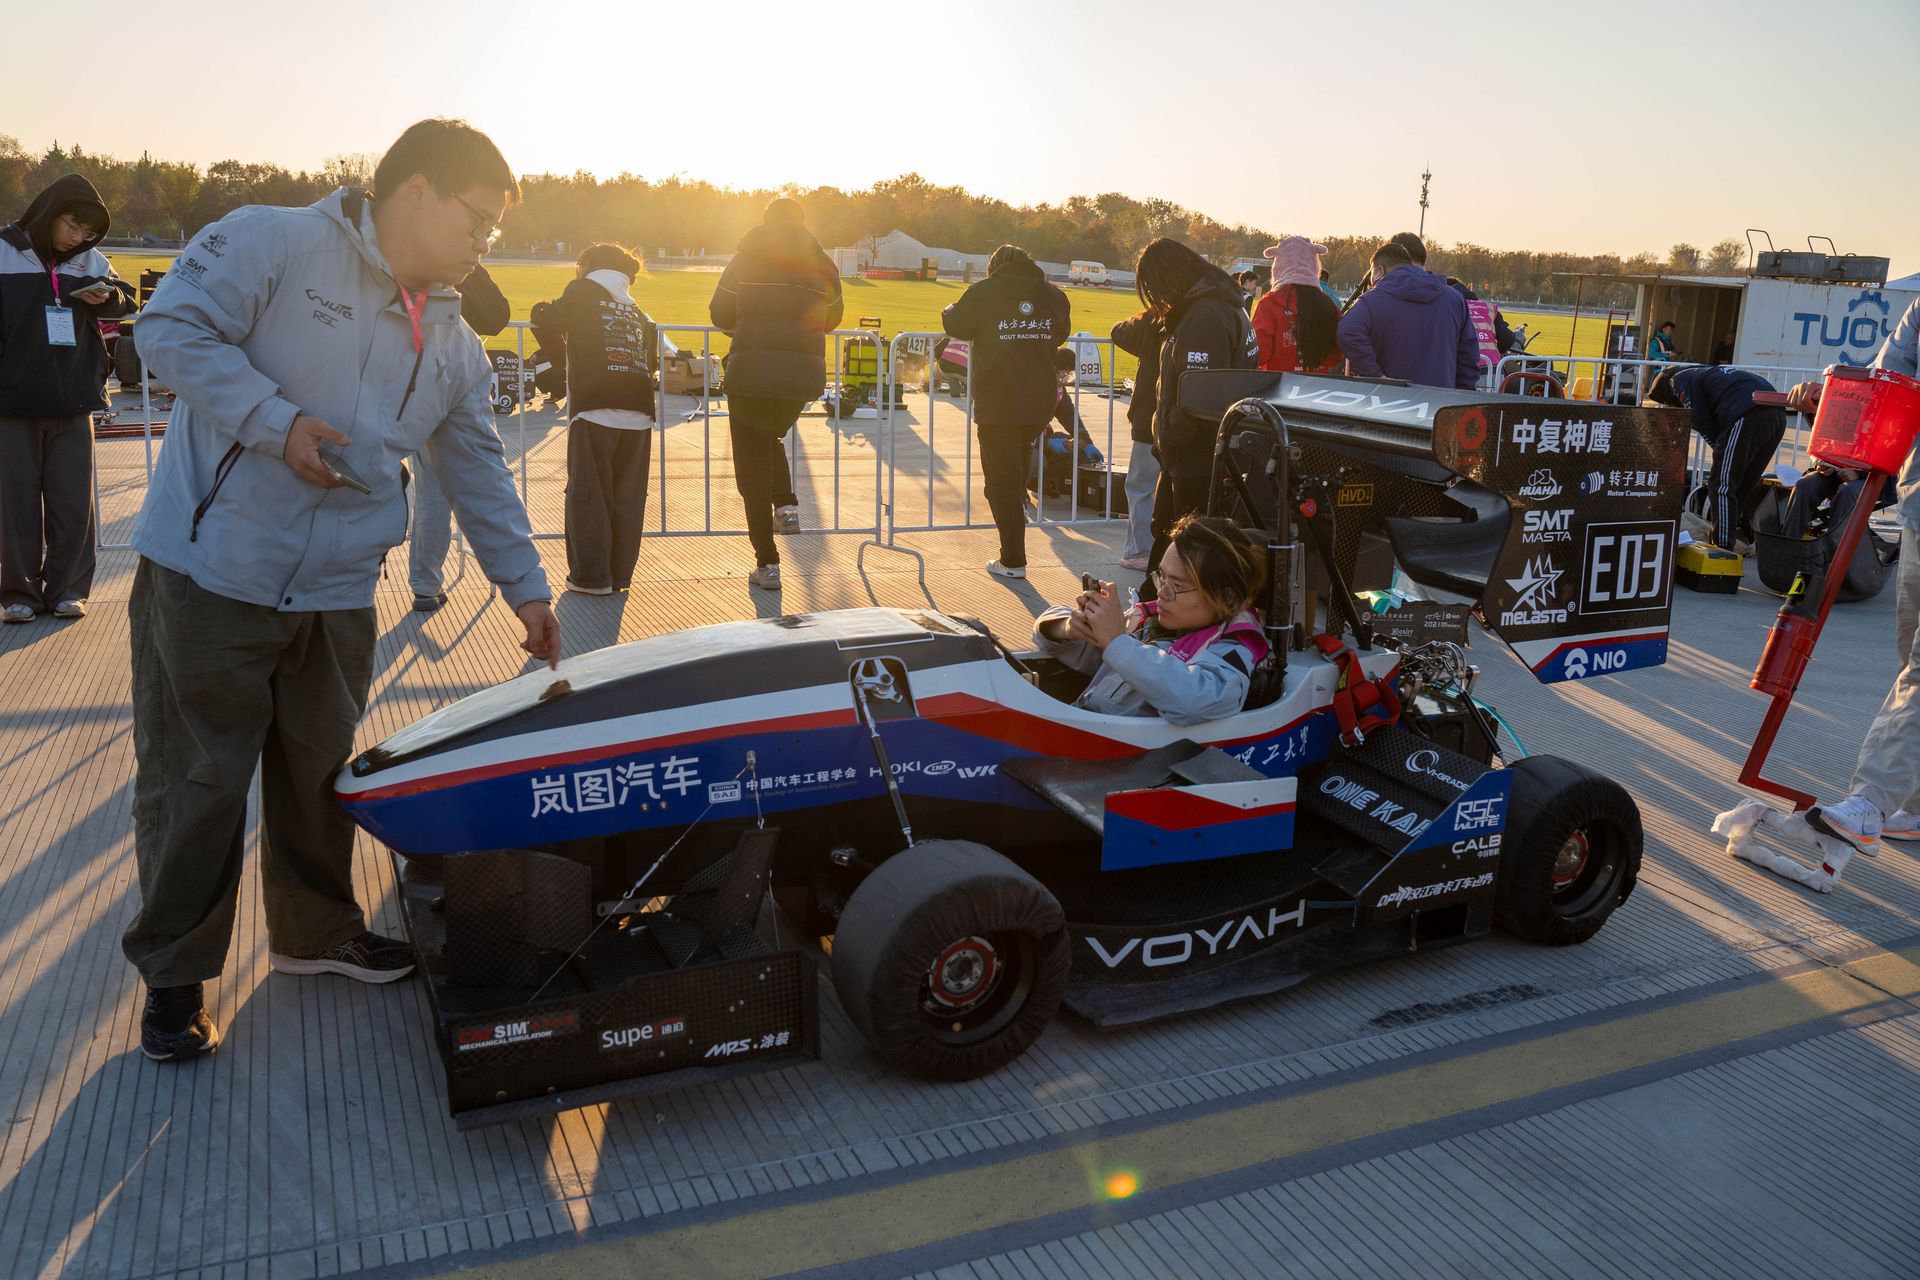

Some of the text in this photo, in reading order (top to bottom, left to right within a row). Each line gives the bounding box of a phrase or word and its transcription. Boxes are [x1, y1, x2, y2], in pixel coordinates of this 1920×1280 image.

[909, 337, 924, 354] A27
[1288, 385, 1434, 419] VOYA
[1512, 418, 1614, 454] 中复神鹰
[1609, 469, 1659, 487] 转子复材
[1519, 485, 1563, 496] HUAHAI
[1523, 509, 1575, 532] SMT
[1522, 531, 1573, 544] MASTA
[1589, 533, 1665, 603] E03
[1593, 649, 1627, 671] NIO
[746, 767, 857, 791] 中国汽车工程学会
[870, 761, 920, 777] HOKI
[531, 755, 702, 818] 岚图汽车
[713, 791, 737, 800] SAE
[1320, 775, 1380, 811] ONE
[1452, 834, 1502, 855] CALB
[1085, 899, 1306, 969] VOYAH
[459, 1030, 554, 1051] MECHANICAL SIMULATION
